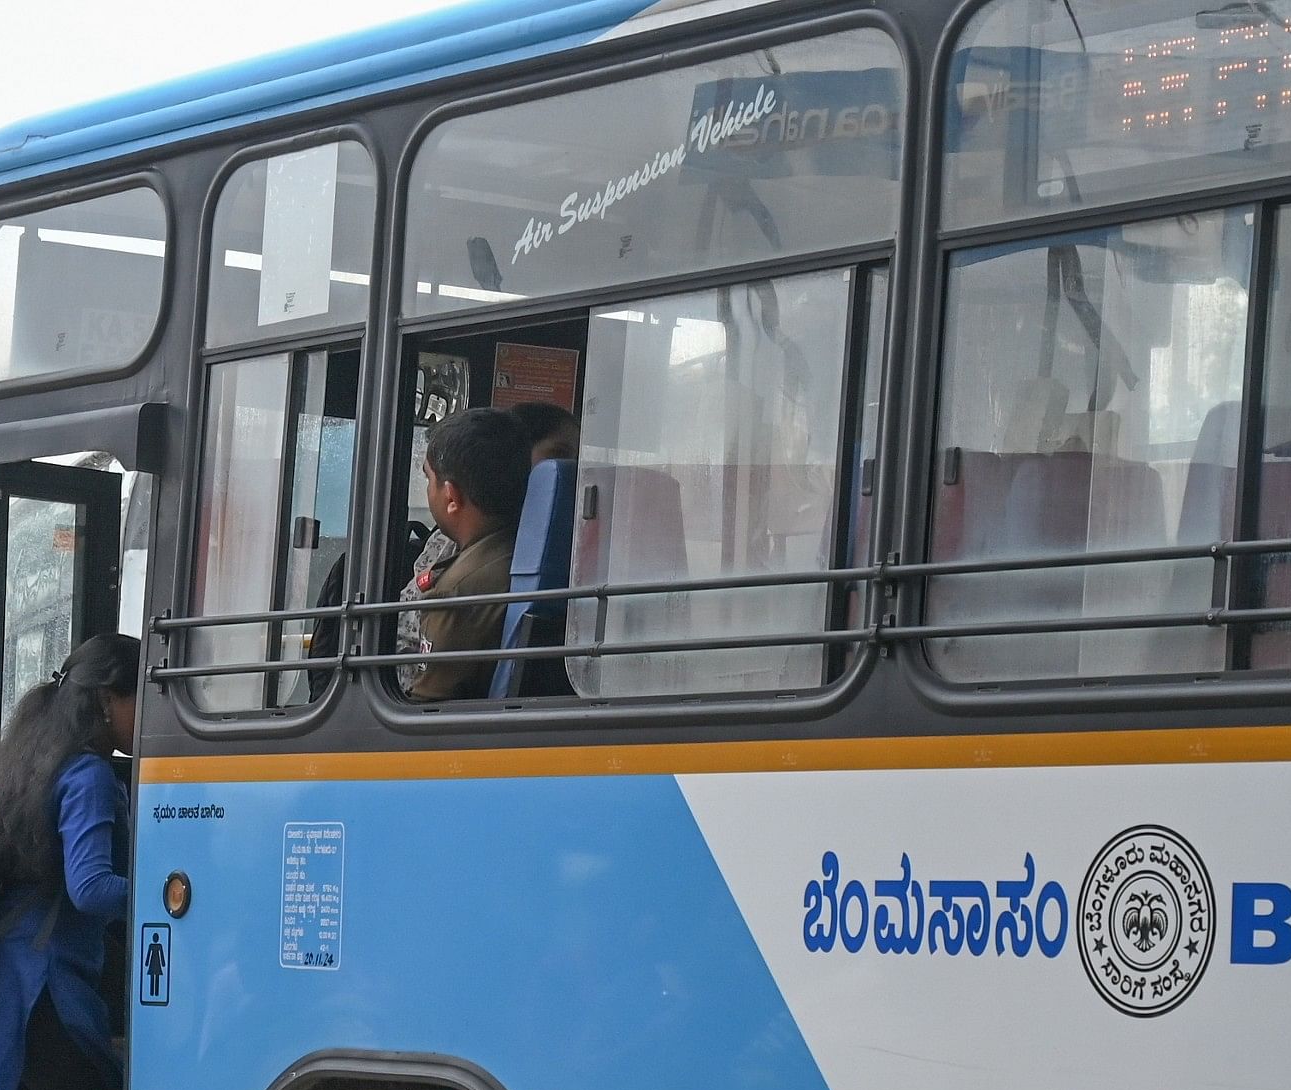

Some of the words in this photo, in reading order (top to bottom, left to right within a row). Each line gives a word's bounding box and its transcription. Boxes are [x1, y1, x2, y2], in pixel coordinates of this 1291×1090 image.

[510, 215, 554, 264] Air
[557, 139, 687, 235] Suspension
[689, 82, 778, 155] Vehicle
[801, 850, 1069, 960] ಬೆಂಮಸಾಸಂ
[1148, 842, 1207, 933] ಮಹಾನಗರ
[1100, 957, 1147, 1000] ಸಾರಿಗೆ
